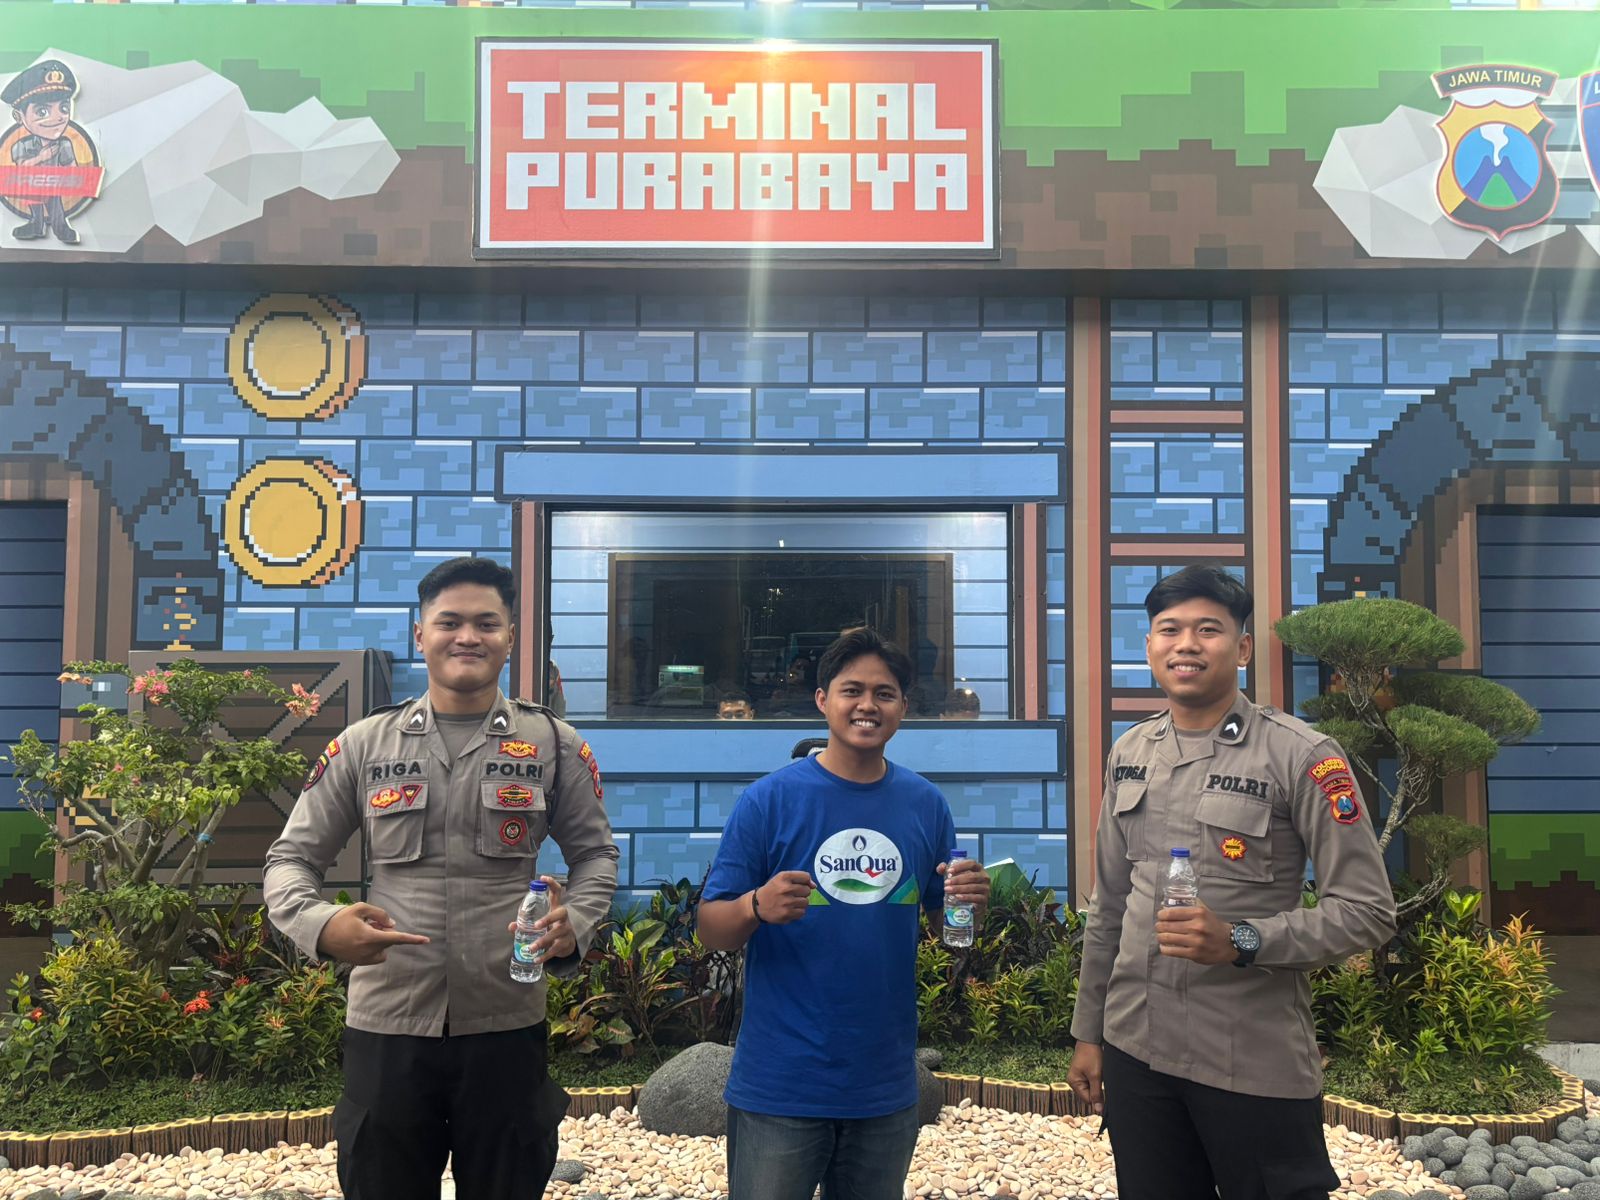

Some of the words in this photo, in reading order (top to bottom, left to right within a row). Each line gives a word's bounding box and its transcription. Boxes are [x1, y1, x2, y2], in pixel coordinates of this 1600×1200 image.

[1449, 70, 1490, 88] JAWA
[1494, 70, 1542, 87] TIMUR
[506, 81, 967, 141] TERMINAL
[505, 152, 968, 211] PURABAYA
[372, 761, 422, 780] RIGA
[486, 762, 544, 779] POLRI
[1206, 774, 1269, 799] POLRI
[819, 854, 897, 878] SanQua
